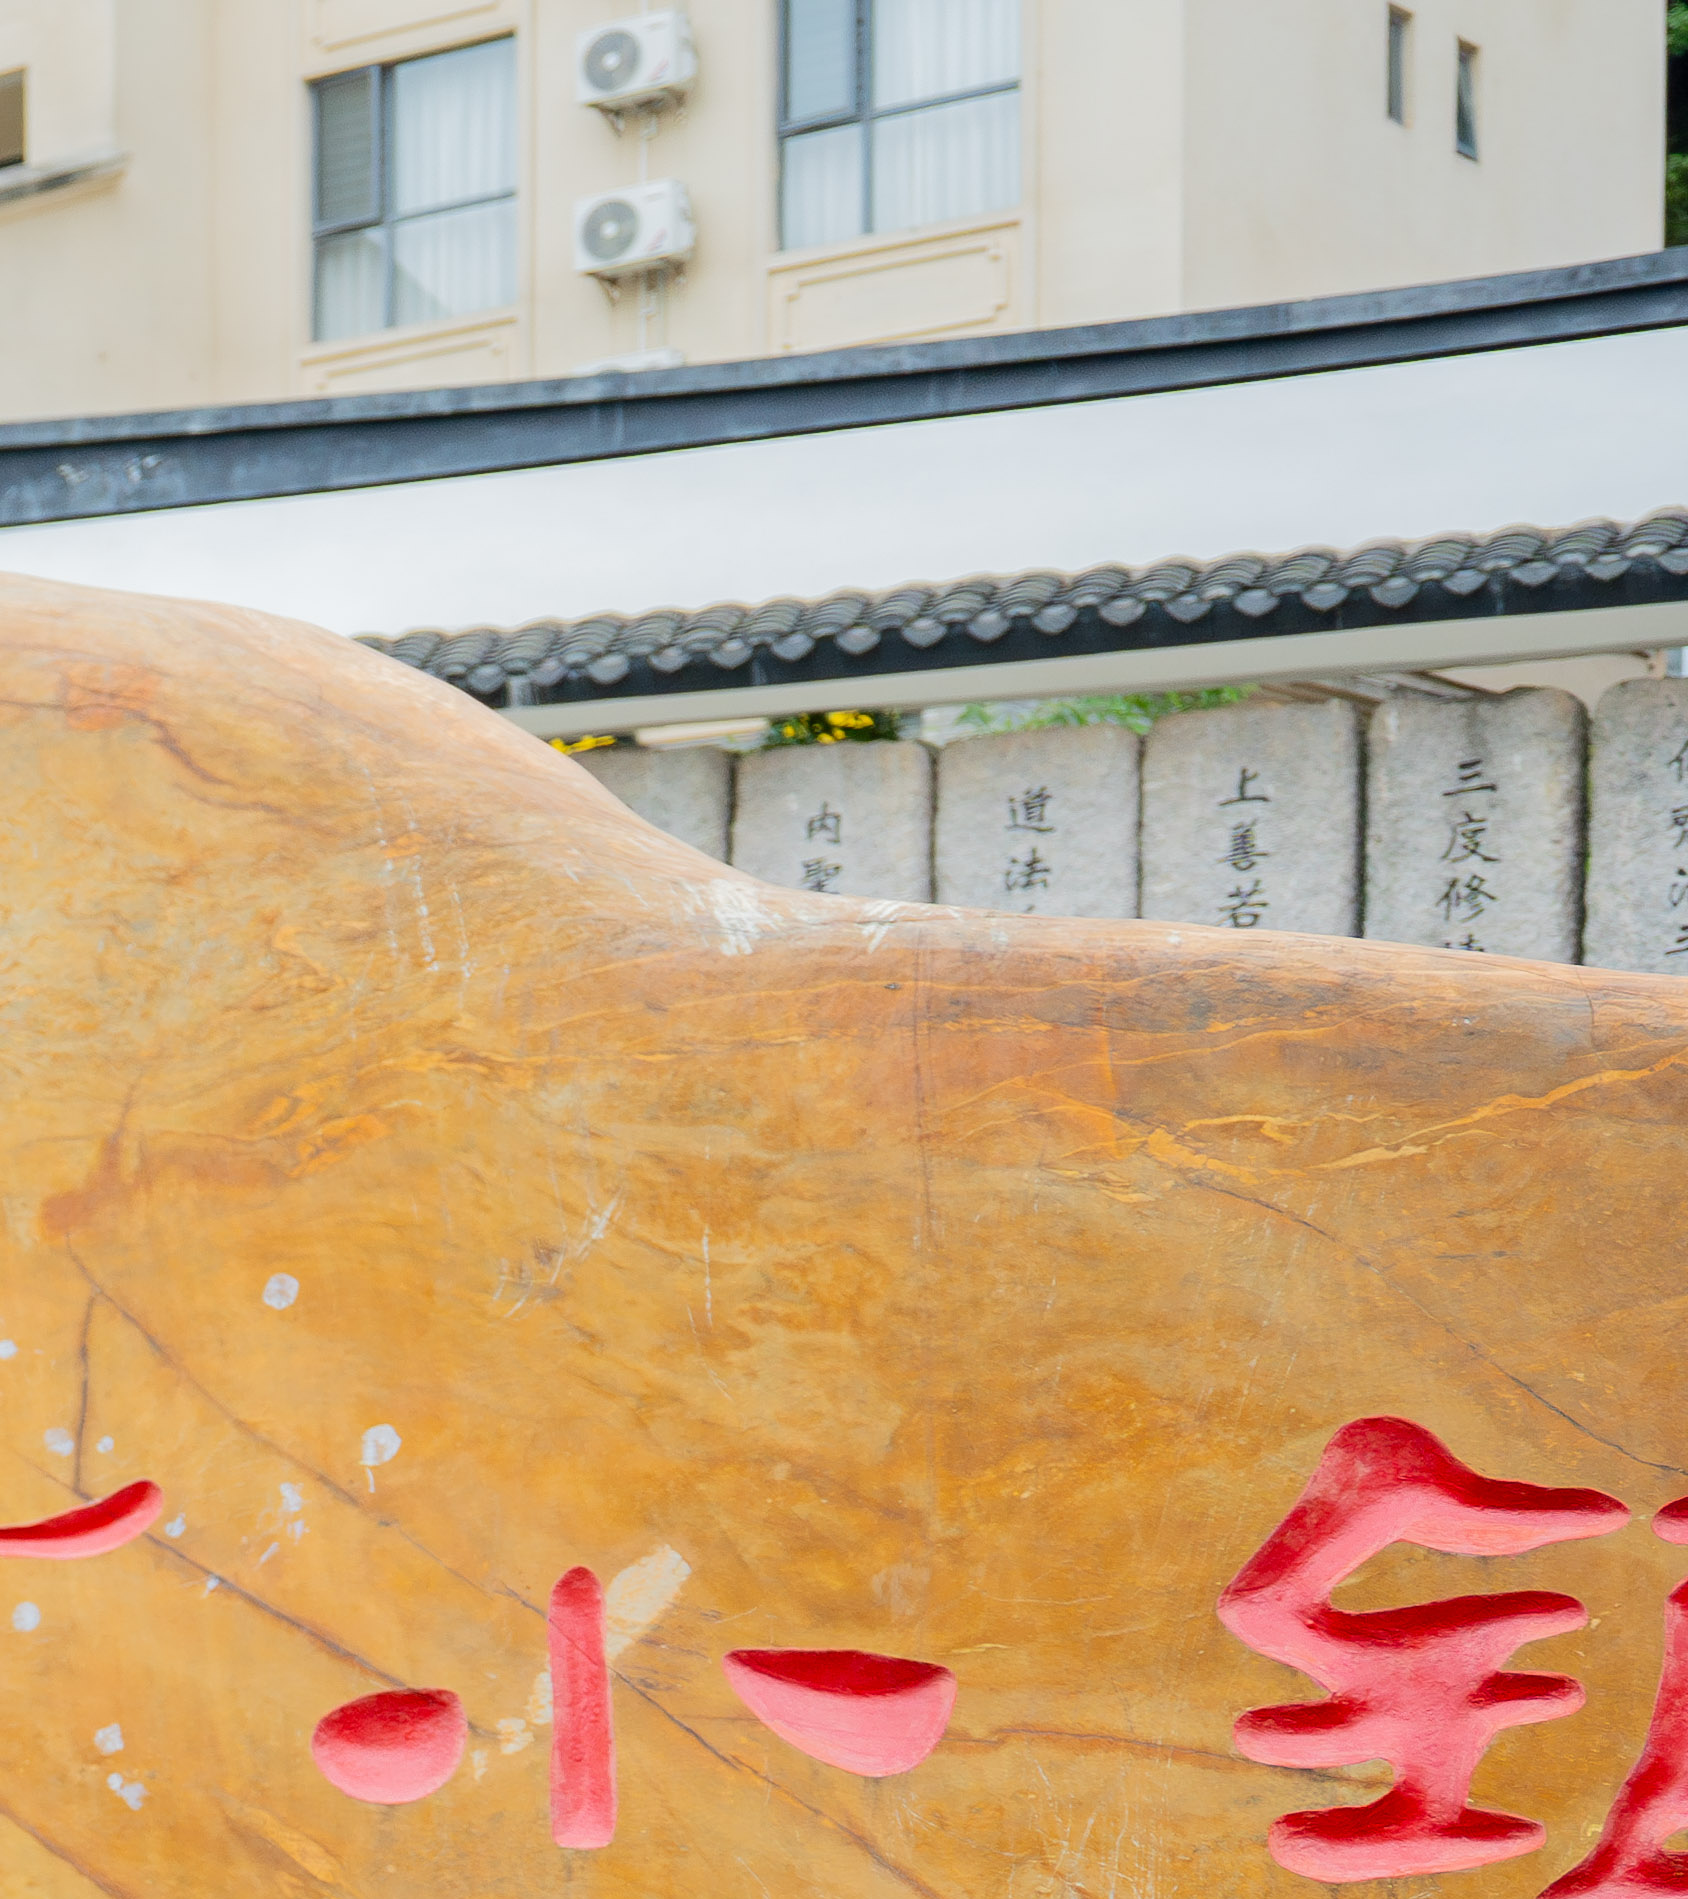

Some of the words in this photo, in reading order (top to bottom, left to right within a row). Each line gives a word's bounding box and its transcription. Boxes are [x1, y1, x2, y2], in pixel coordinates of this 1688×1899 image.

[1003, 785, 1057, 913] 道法
[1216, 767, 1272, 928] 上善若
[1436, 758, 1501, 952] 三度修
